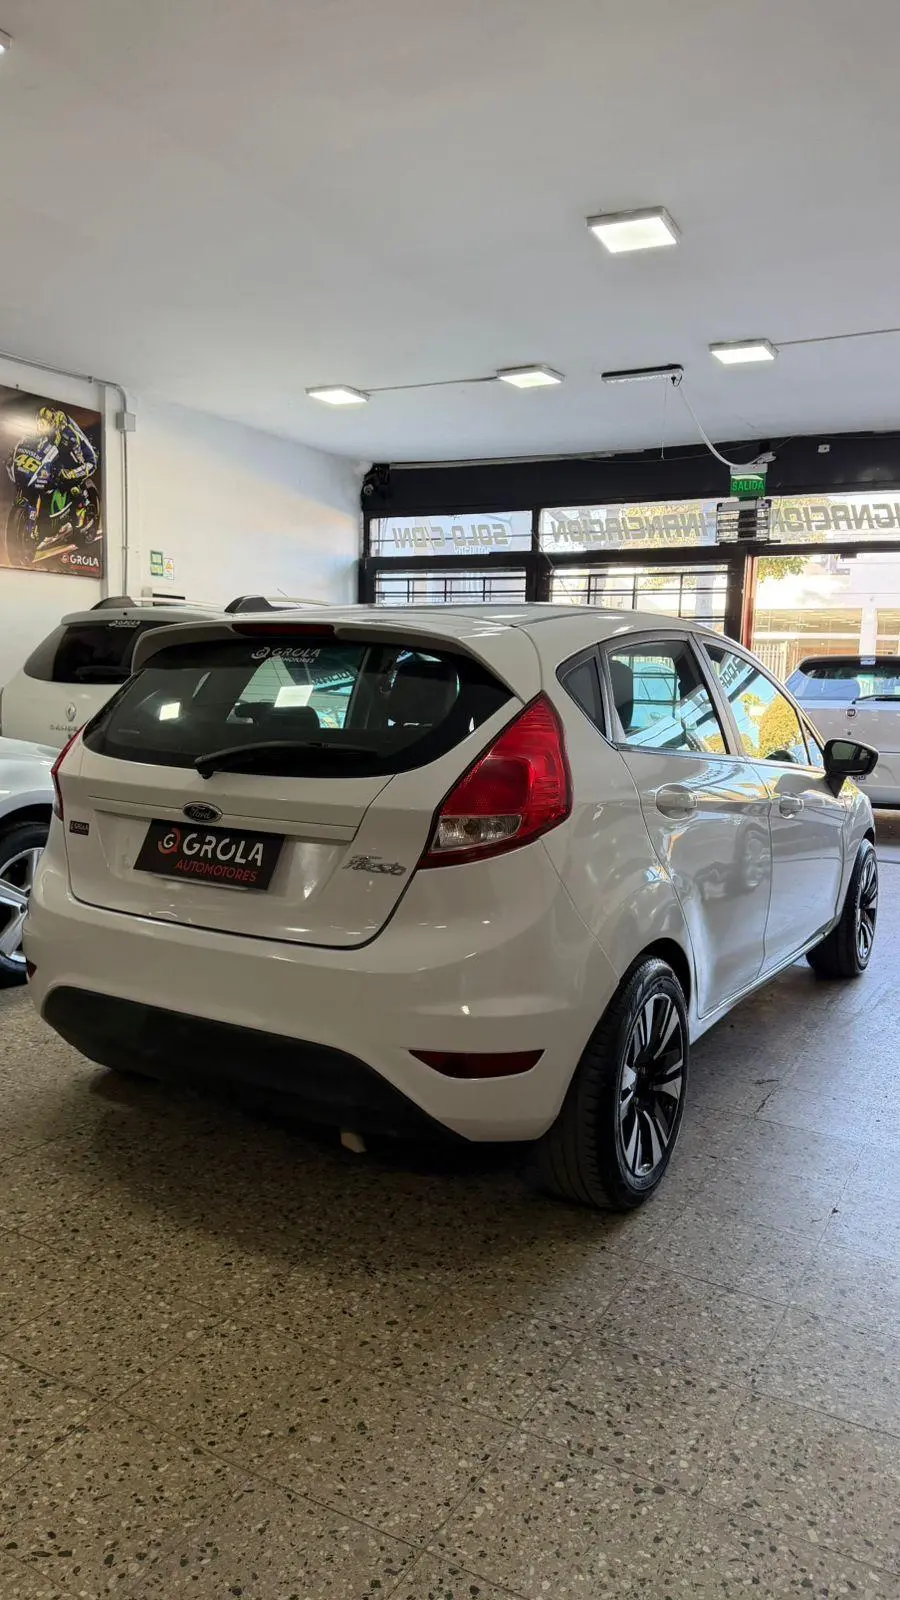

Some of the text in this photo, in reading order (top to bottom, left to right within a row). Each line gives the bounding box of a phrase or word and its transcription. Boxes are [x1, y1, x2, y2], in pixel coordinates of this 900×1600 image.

[14, 454, 42, 472] 46
[732, 480, 764, 492] SALIDA
[69, 554, 100, 567] GROLA
[272, 648, 321, 658] GROLA
[189, 806, 213, 820] Ford
[182, 833, 265, 867] GROLA
[175, 858, 259, 882] AUTOMOTORES
